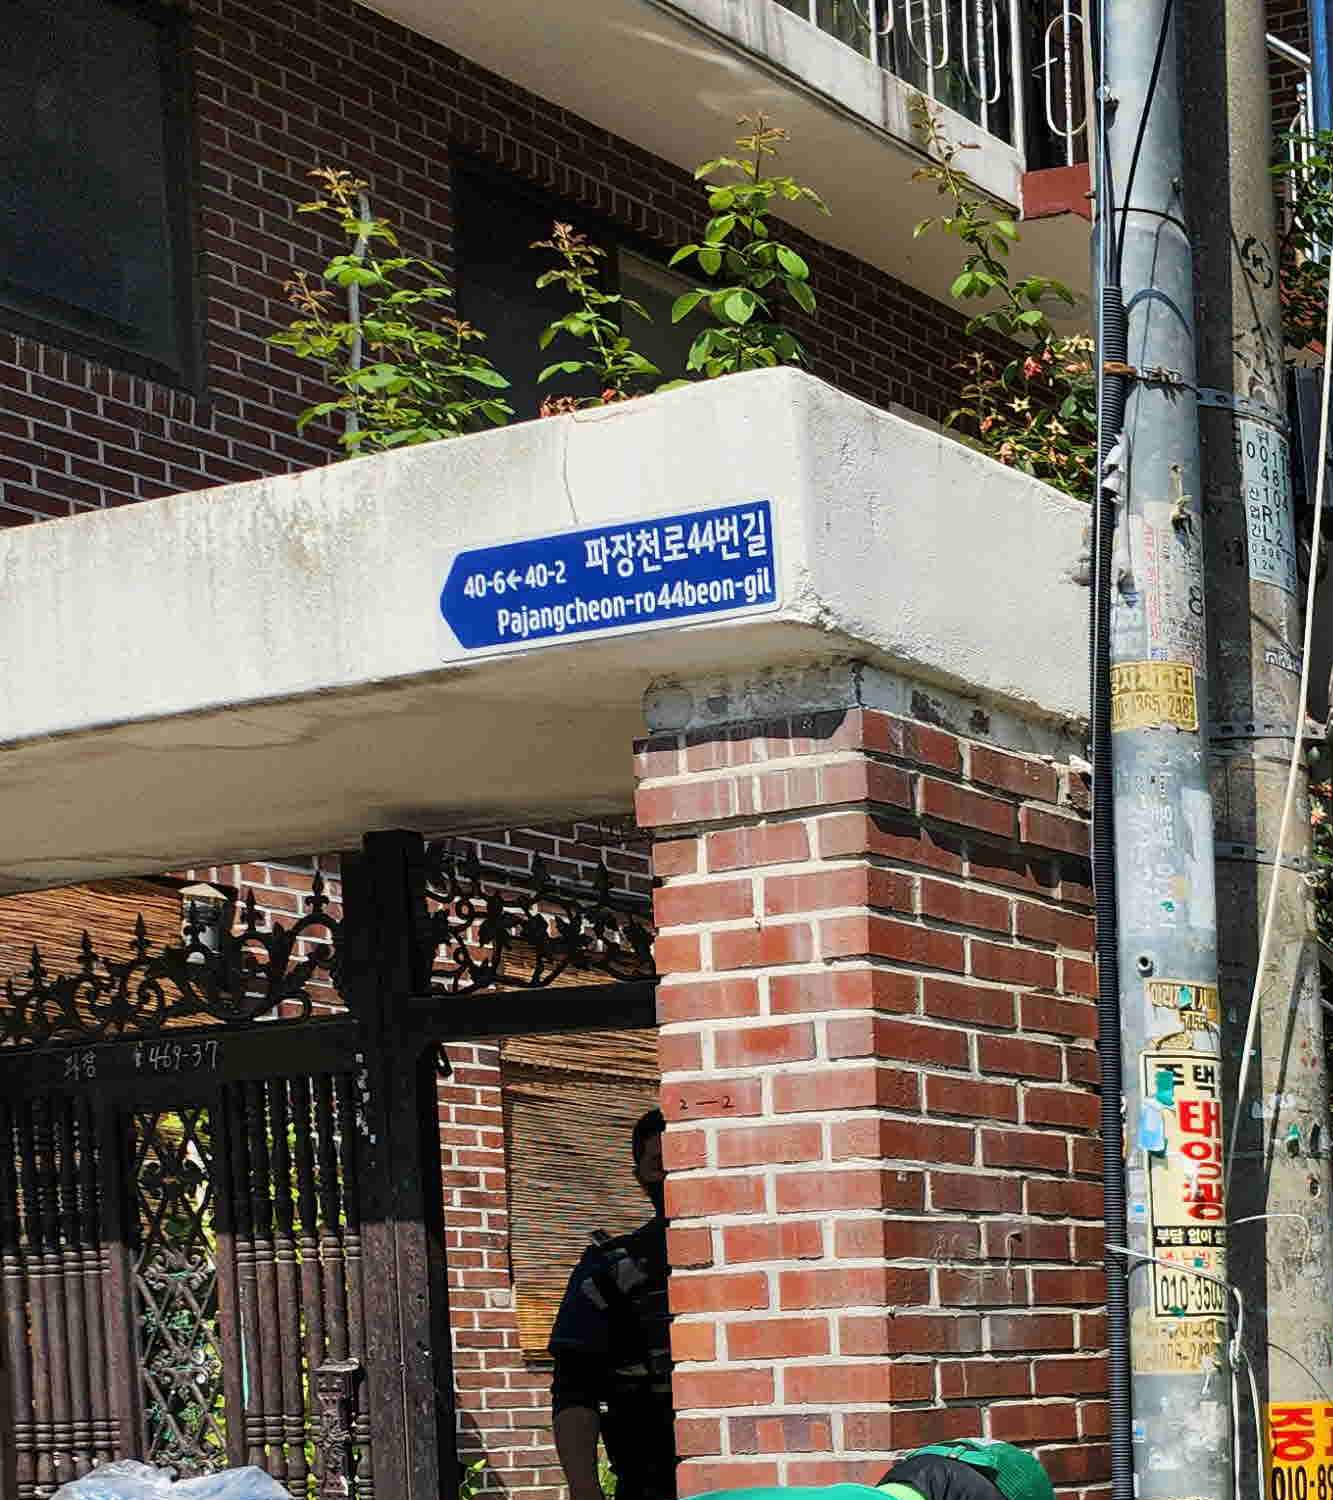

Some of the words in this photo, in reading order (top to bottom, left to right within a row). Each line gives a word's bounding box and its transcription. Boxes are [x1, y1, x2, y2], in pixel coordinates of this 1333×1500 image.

[524, 560, 567, 588] 40-2
[584, 510, 768, 577] 파장천로44번길
[1157, 1229, 1183, 1244] 부담
[1187, 1228, 1213, 1244] 없이
